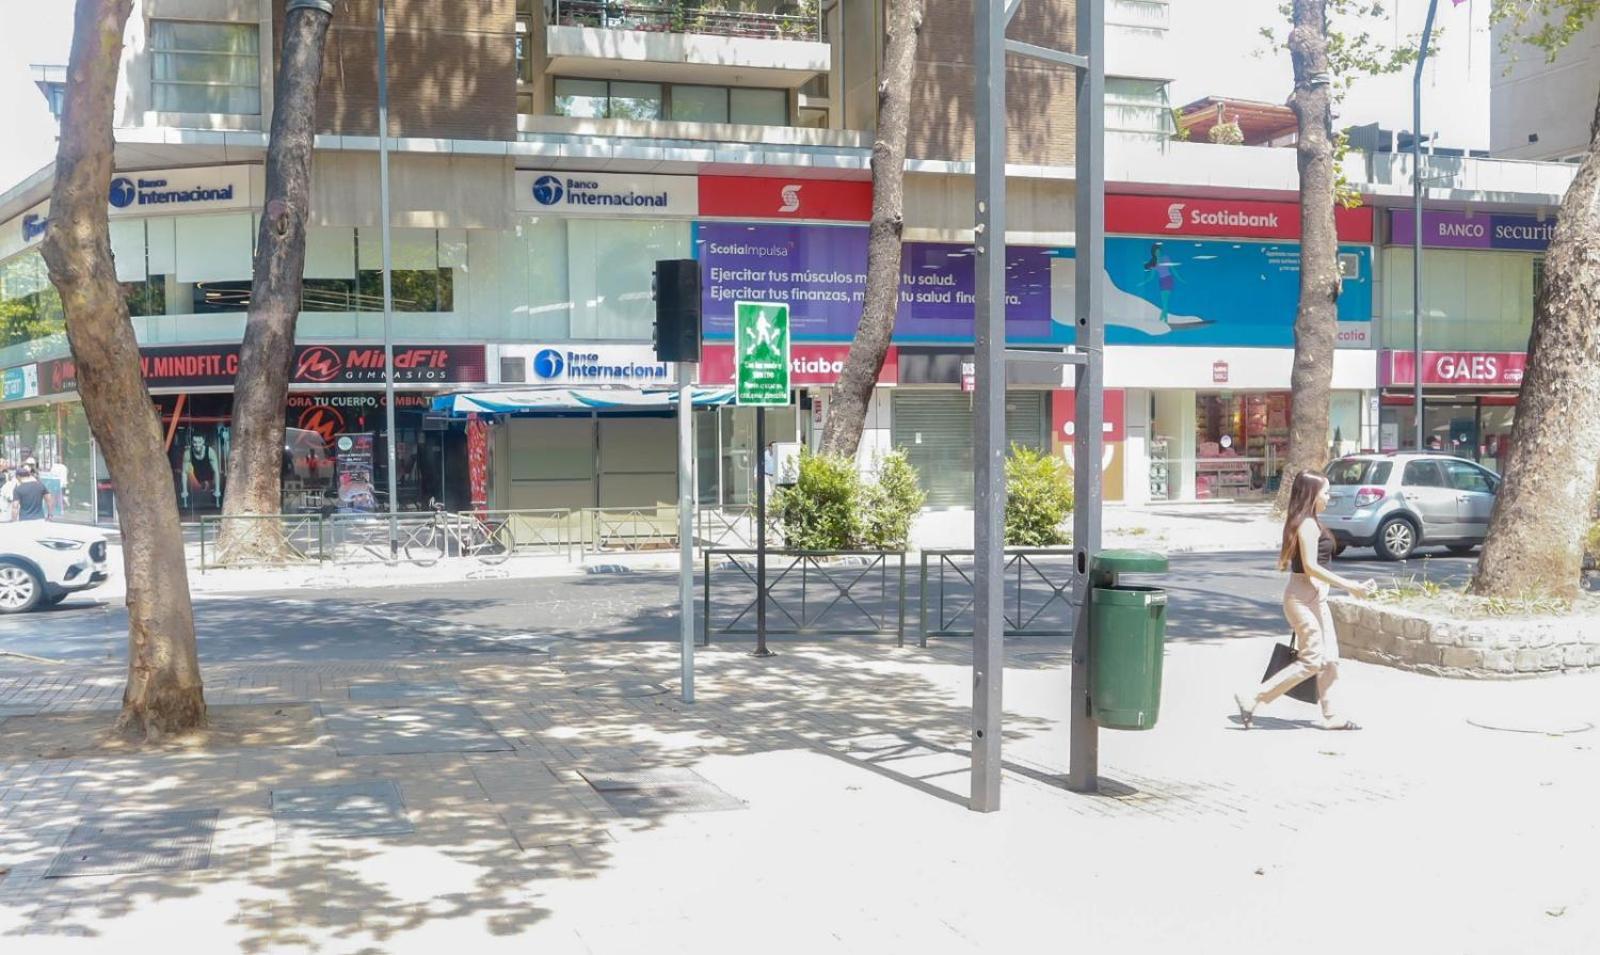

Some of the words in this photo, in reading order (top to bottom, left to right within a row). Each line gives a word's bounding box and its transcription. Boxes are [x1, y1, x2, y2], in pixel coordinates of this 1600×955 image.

[138, 179, 167, 188] Banco
[567, 179, 598, 189] Banco
[138, 185, 233, 205] Internacional
[567, 191, 668, 207] Internacional
[1191, 209, 1278, 228] Scotiabank
[1439, 223, 1484, 237] BANCO
[1496, 223, 1553, 240] securit
[710, 243, 788, 257] ScotiaImpulsa
[710, 268, 766, 283] Ejercitar
[769, 270, 788, 282] tus
[791, 270, 853, 284] músculos
[903, 273, 915, 285] tu
[918, 273, 956, 286] salud.
[710, 286, 766, 301] Ejercitar
[768, 287, 788, 300] tus
[791, 288, 850, 303] finanzas,
[901, 291, 913, 303] tu
[916, 291, 951, 303] salud
[1338, 329, 1365, 341] cotia
[567, 351, 599, 362] Banco
[567, 362, 668, 378] Internacional
[1437, 356, 1497, 379] GAES
[288, 397, 311, 406] ORA
[314, 396, 328, 406] TU
[331, 396, 378, 408] CUERPO,
[380, 396, 424, 406] CMBIA
